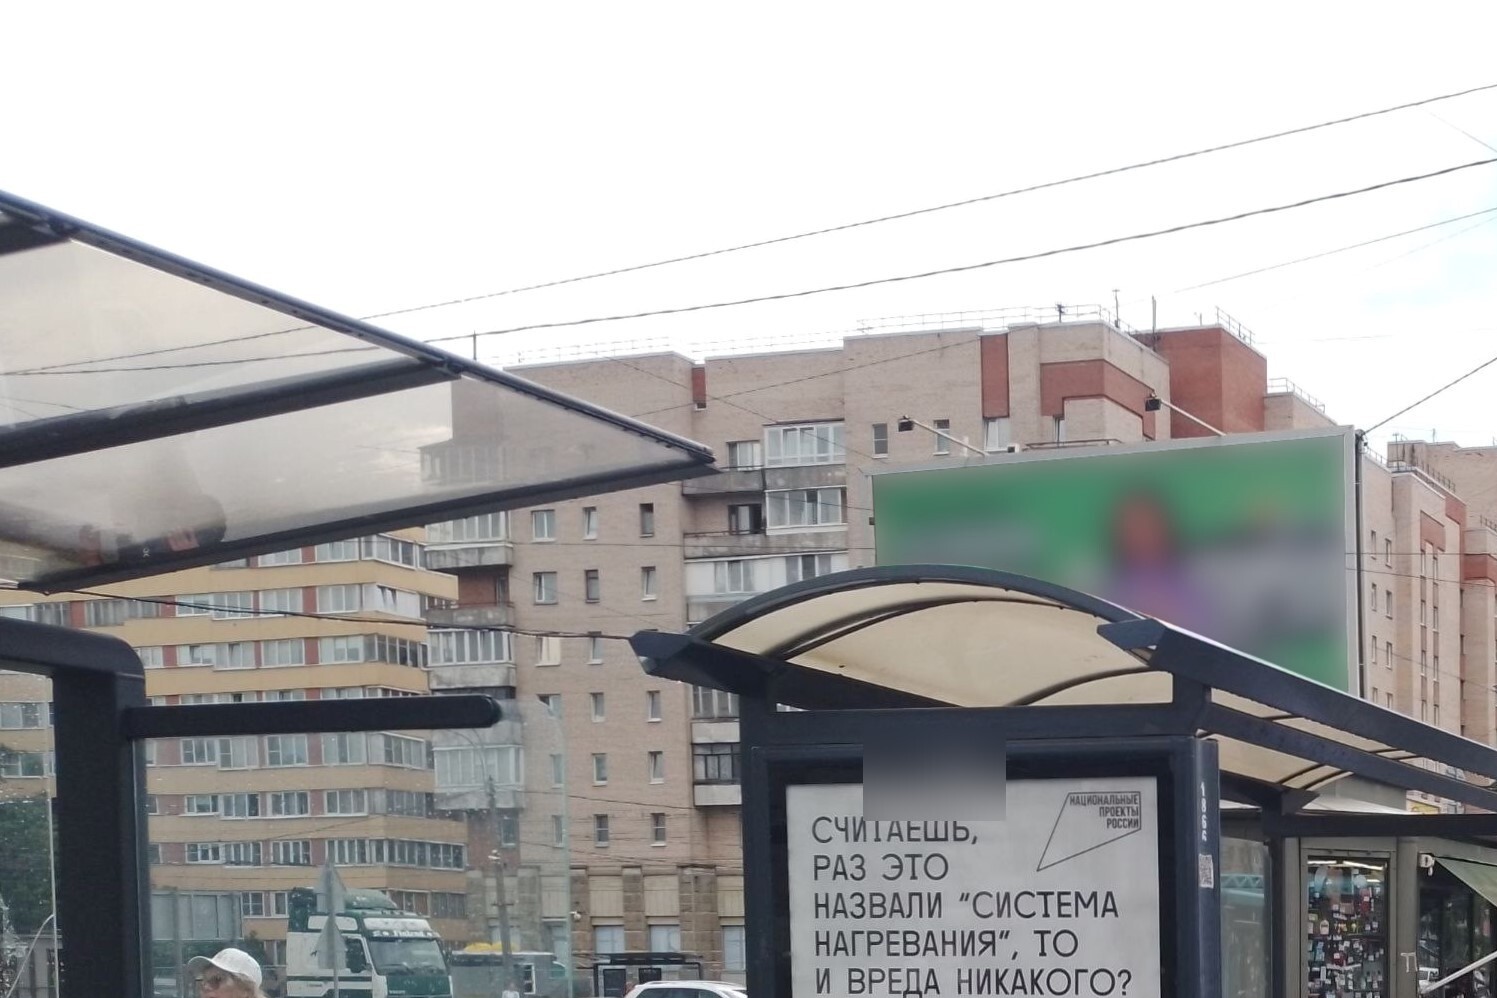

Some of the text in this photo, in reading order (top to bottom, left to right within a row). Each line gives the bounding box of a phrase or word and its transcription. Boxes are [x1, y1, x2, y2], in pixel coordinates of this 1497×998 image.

[1070, 794, 1139, 806] НАЦИОНАЛЬНЫЕ
[1099, 806, 1139, 817] ПРОЕКТЫ
[812, 816, 977, 845] СЧИТАЕШЬ,
[1106, 818, 1139, 829] РОССИИ
[813, 853, 949, 881] РАЗ ЭТО
[814, 891, 942, 919] НАЗВАЛИ
[1034, 929, 1078, 957] ТО
[816, 968, 1132, 998] И ВРЕДА НИКАКОГО?
